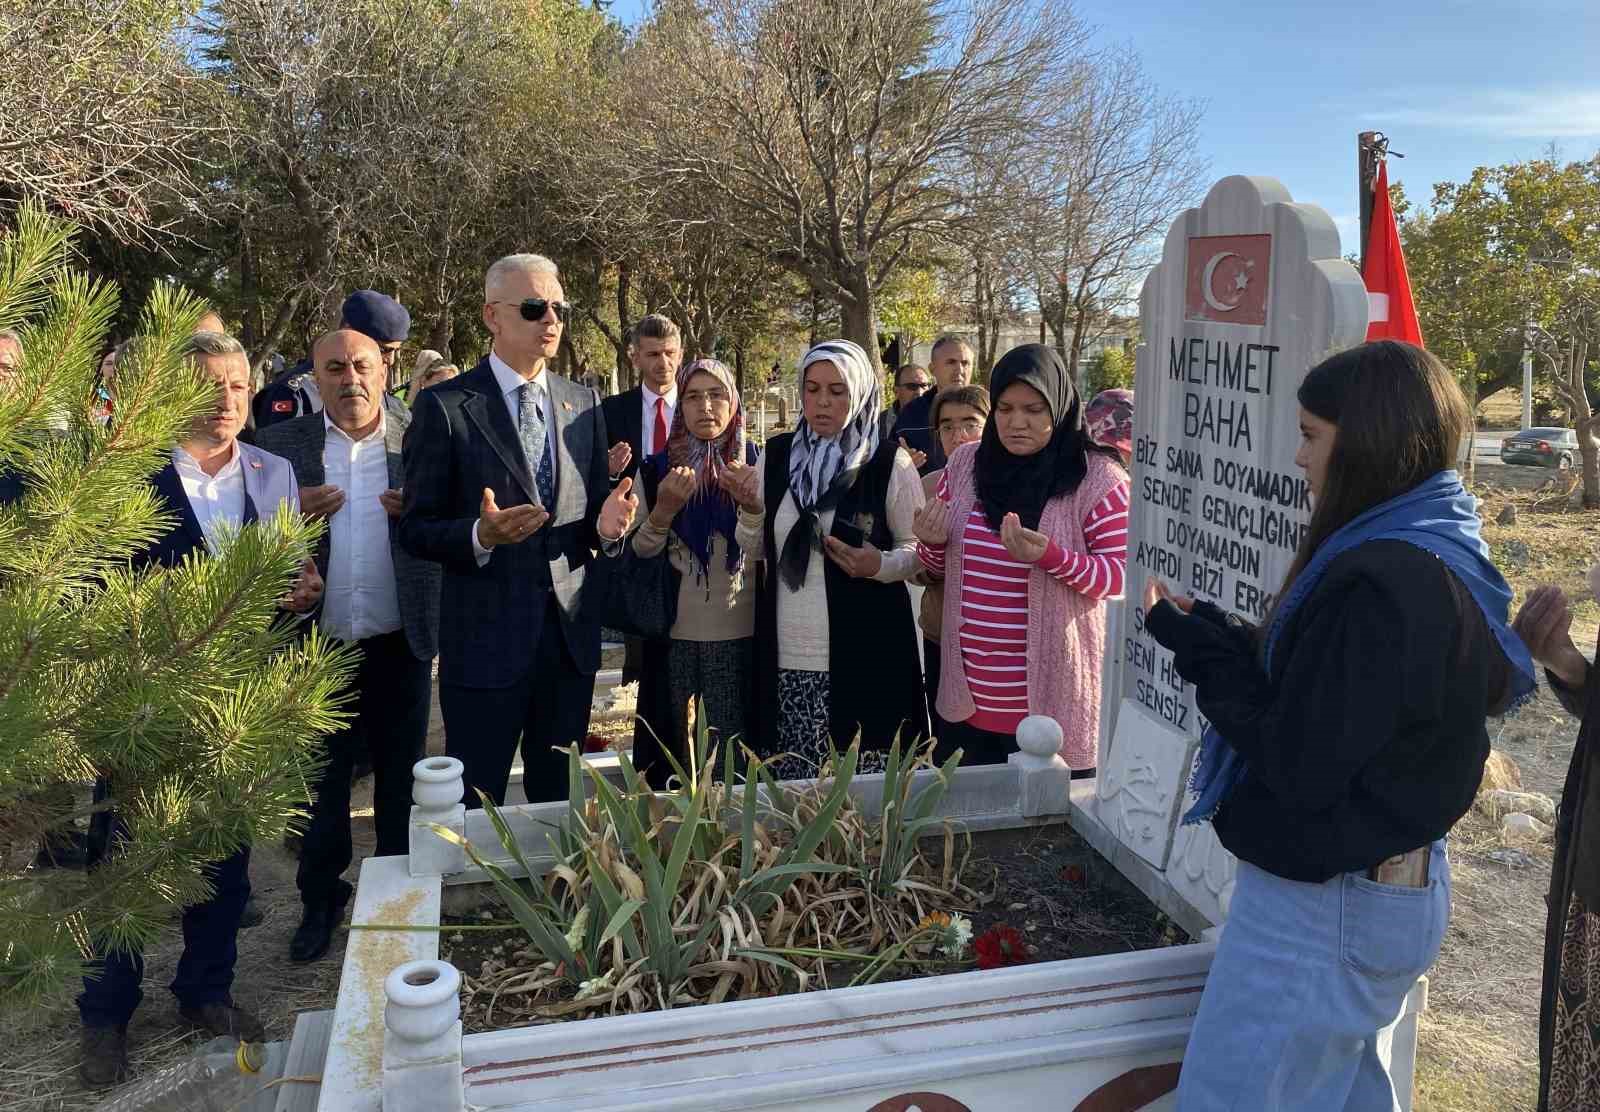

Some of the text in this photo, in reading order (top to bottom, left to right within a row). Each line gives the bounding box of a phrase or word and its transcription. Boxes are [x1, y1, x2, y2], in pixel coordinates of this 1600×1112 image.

[1169, 336, 1280, 395] MEHMET
[1184, 391, 1252, 452] BAHA
[1136, 434, 1312, 512] BİZ SANA DOYAMADIK
[1143, 476, 1192, 515] SENDE
[1135, 540, 1182, 582] AYIRDI
[1191, 560, 1225, 599] BİZİ
[1166, 517, 1261, 579] DOYAMADIN
[1136, 678, 1189, 732] SENSİZ
